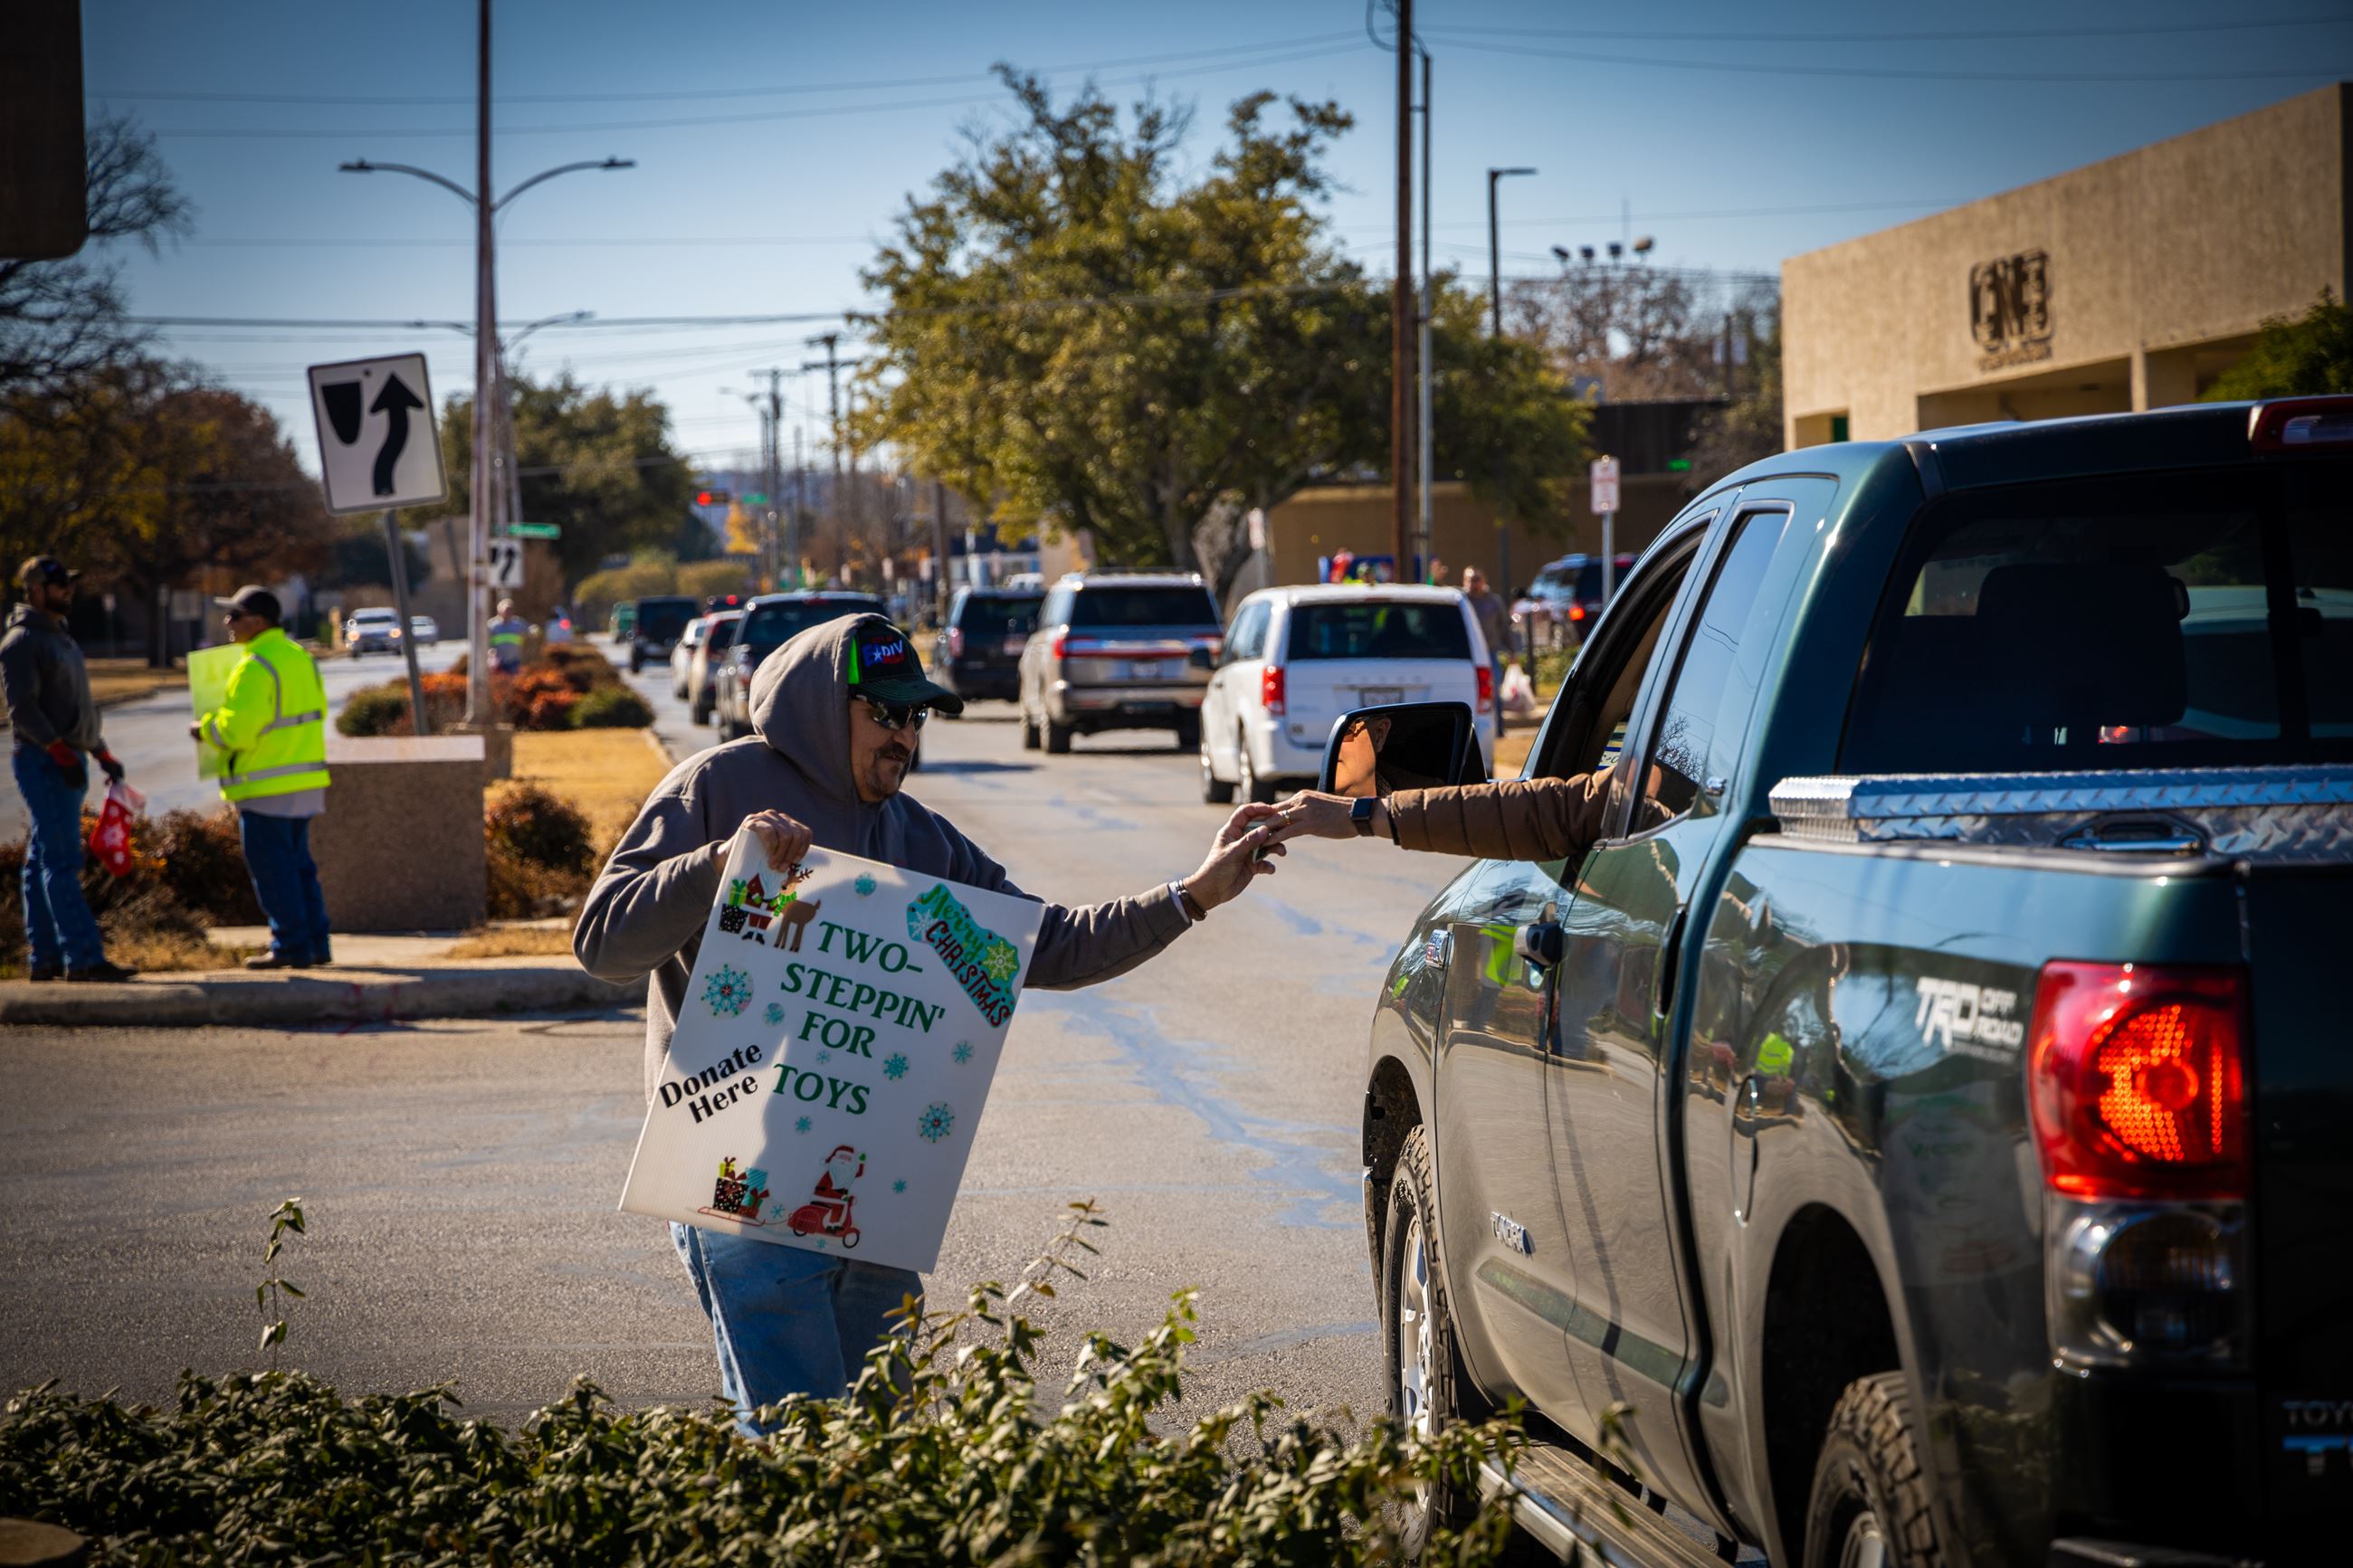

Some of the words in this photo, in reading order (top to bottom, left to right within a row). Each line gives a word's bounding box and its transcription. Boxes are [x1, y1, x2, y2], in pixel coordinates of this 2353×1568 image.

[817, 920, 924, 974] TWO-
[920, 886, 985, 963] Merry
[780, 962, 947, 1034] STEPPIN'
[926, 920, 1012, 1028] CHRISTMAS
[797, 1010, 873, 1059] FOR
[1915, 976, 1981, 1050] TRD
[659, 1044, 763, 1109] Donate
[688, 1075, 758, 1124] Here
[773, 1063, 871, 1116] TOYS
